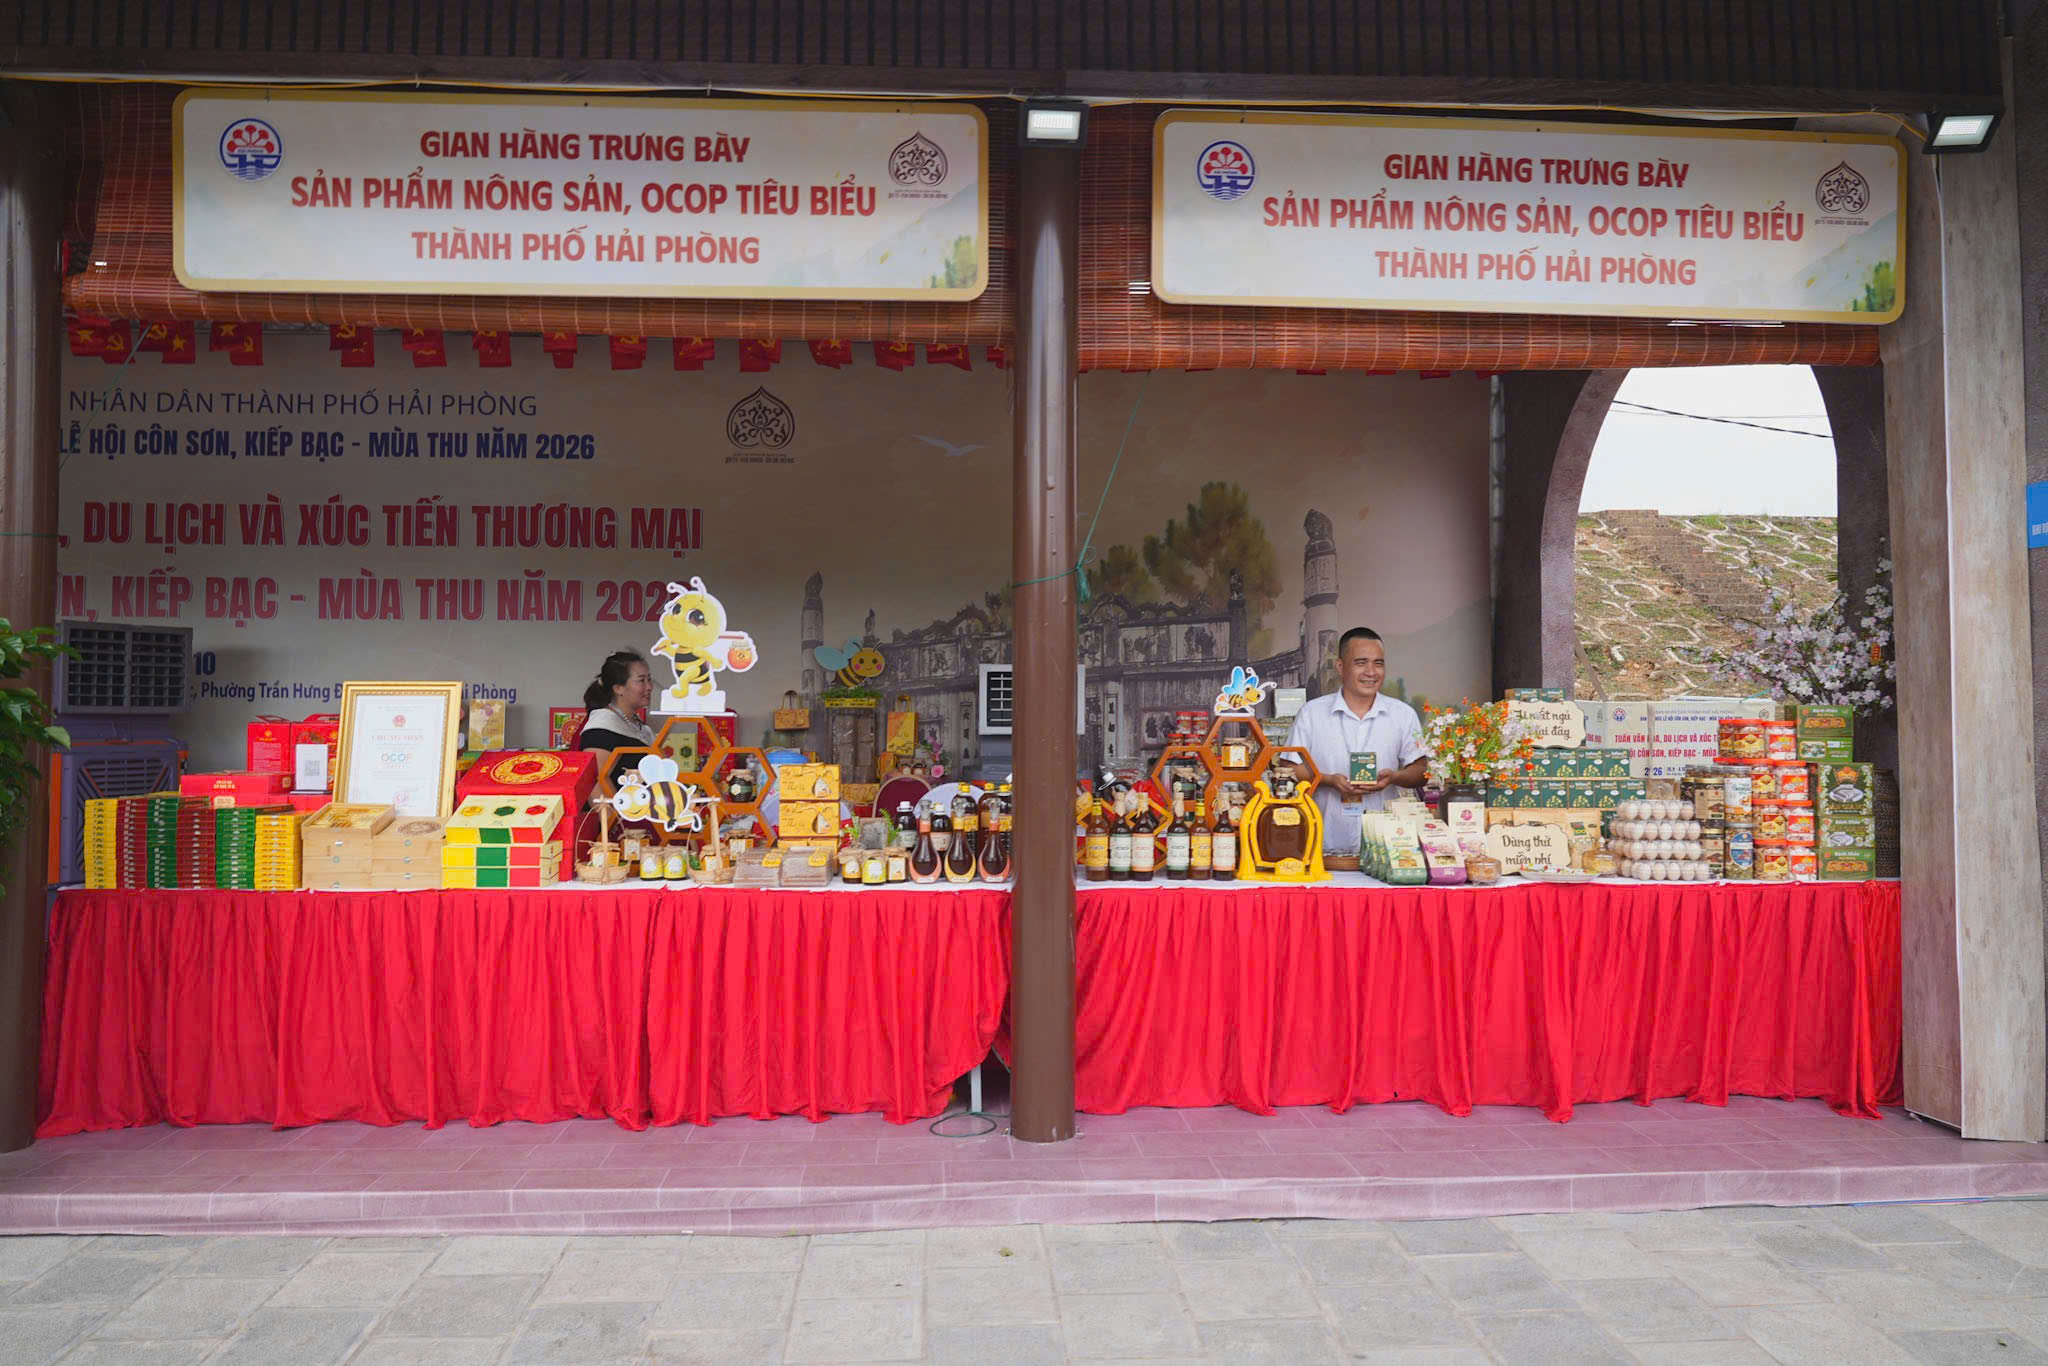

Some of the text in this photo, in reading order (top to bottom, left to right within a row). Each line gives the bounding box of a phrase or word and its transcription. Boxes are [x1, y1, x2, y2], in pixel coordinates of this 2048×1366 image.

[421, 128, 750, 162] GIAN HÀNG TRƯNG BÀY
[1384, 152, 1689, 188] GIAN HÀNG TRƯNG BÀY
[291, 166, 875, 216] SẢN PHẨM NÔNG SẢN, OCOP TIÊU BIỂU
[1264, 188, 1803, 241] SẢN PHẨM NÔNG SẢN, OCOP TIÊU BIỂU
[412, 226, 759, 264] THÀNH PHỐ HẢI PHÒNG
[1375, 247, 1696, 285] THÀNH PHỐ HẢI PHÒNG
[70, 388, 536, 416] NHÂN DÂN THÀNH PHỐ HẢI PHÒNG
[90, 424, 125, 460] HỘI
[134, 423, 177, 455] CÔN
[186, 428, 236, 459] SƠN,
[245, 425, 293, 456] KIẾP
[302, 432, 343, 462] BẠC
[369, 426, 418, 457] MÙA
[427, 432, 468, 458] THU
[477, 427, 527, 458] NĂM
[536, 434, 594, 459] 2026
[84, 494, 703, 559] DU LỊCH VÀ XÚC TIẾN THƯƠNG MẠI
[112, 566, 192, 618] KIẾP
[206, 577, 278, 627] BẠC
[319, 568, 403, 620] MÙA
[416, 579, 484, 620] THU
[497, 569, 580, 621] NĂM
[596, 580, 690, 623] 202
[201, 682, 255, 702] Phường
[259, 680, 289, 699] Trần
[293, 683, 331, 703] Hưng
[472, 683, 517, 704] Phòng
[1502, 834, 1531, 851] Dùng
[1533, 834, 1552, 847] thử
